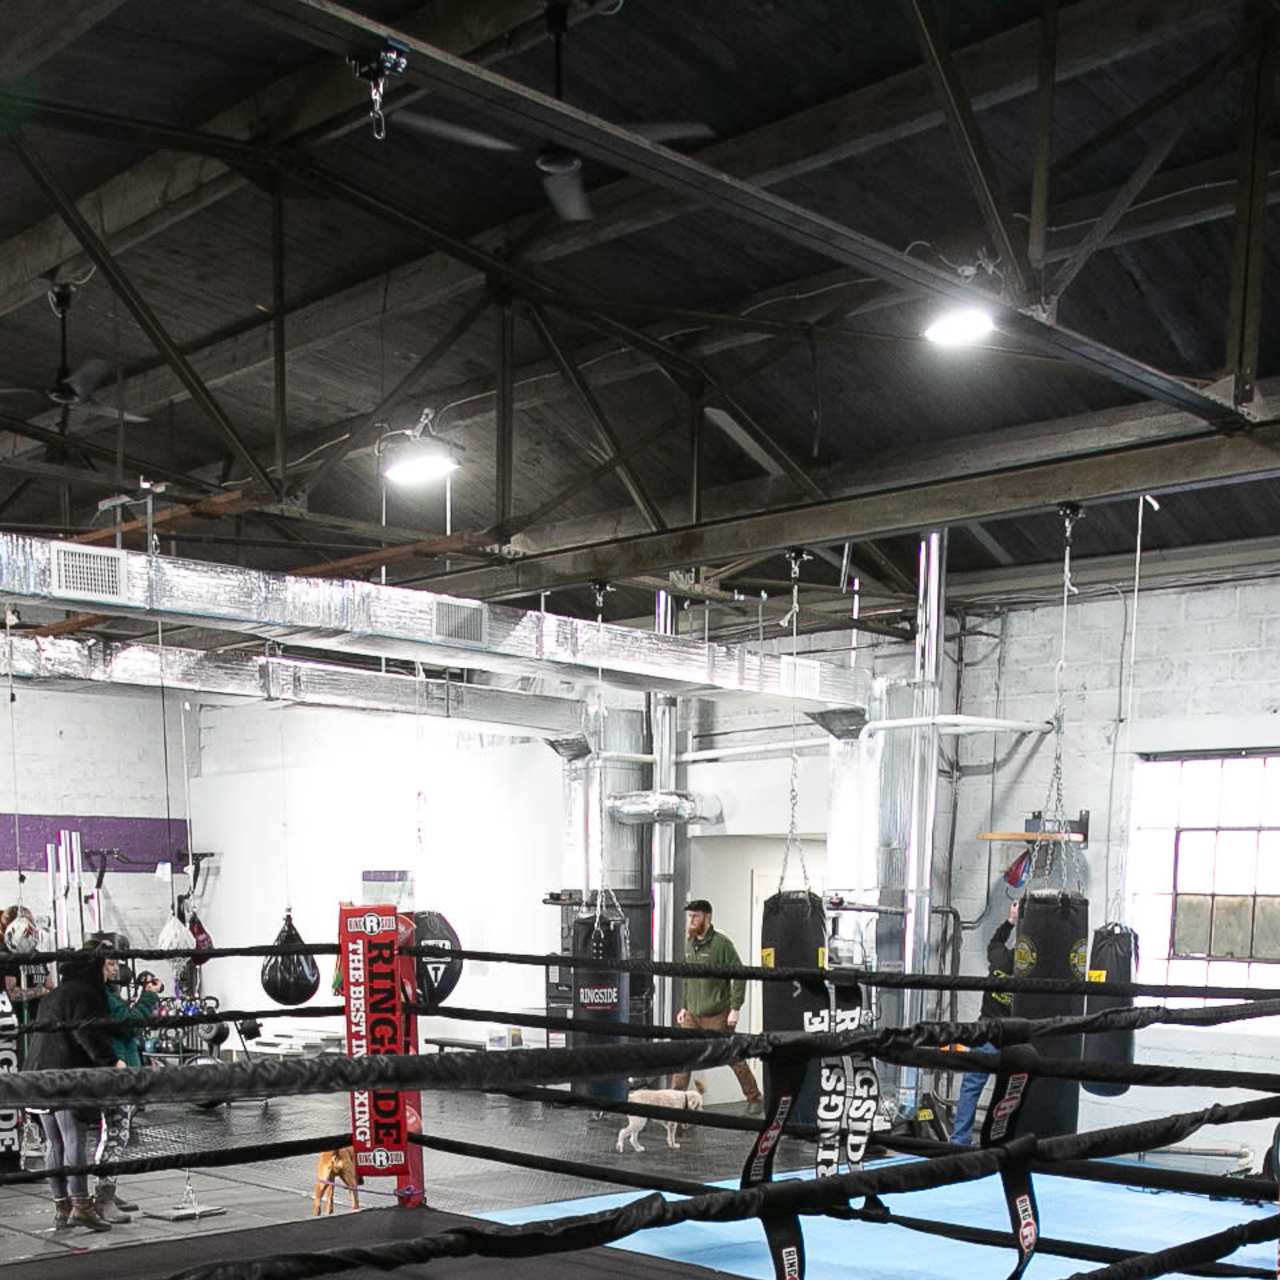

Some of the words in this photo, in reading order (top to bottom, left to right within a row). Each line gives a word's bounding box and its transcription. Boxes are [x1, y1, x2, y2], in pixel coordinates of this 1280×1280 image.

[349, 940, 364, 981] THE
[350, 985, 366, 1035] BEST
[579, 988, 618, 1003] RINGSIDE
[367, 940, 401, 1145] RINGDE
[353, 1073, 369, 1141] XING
